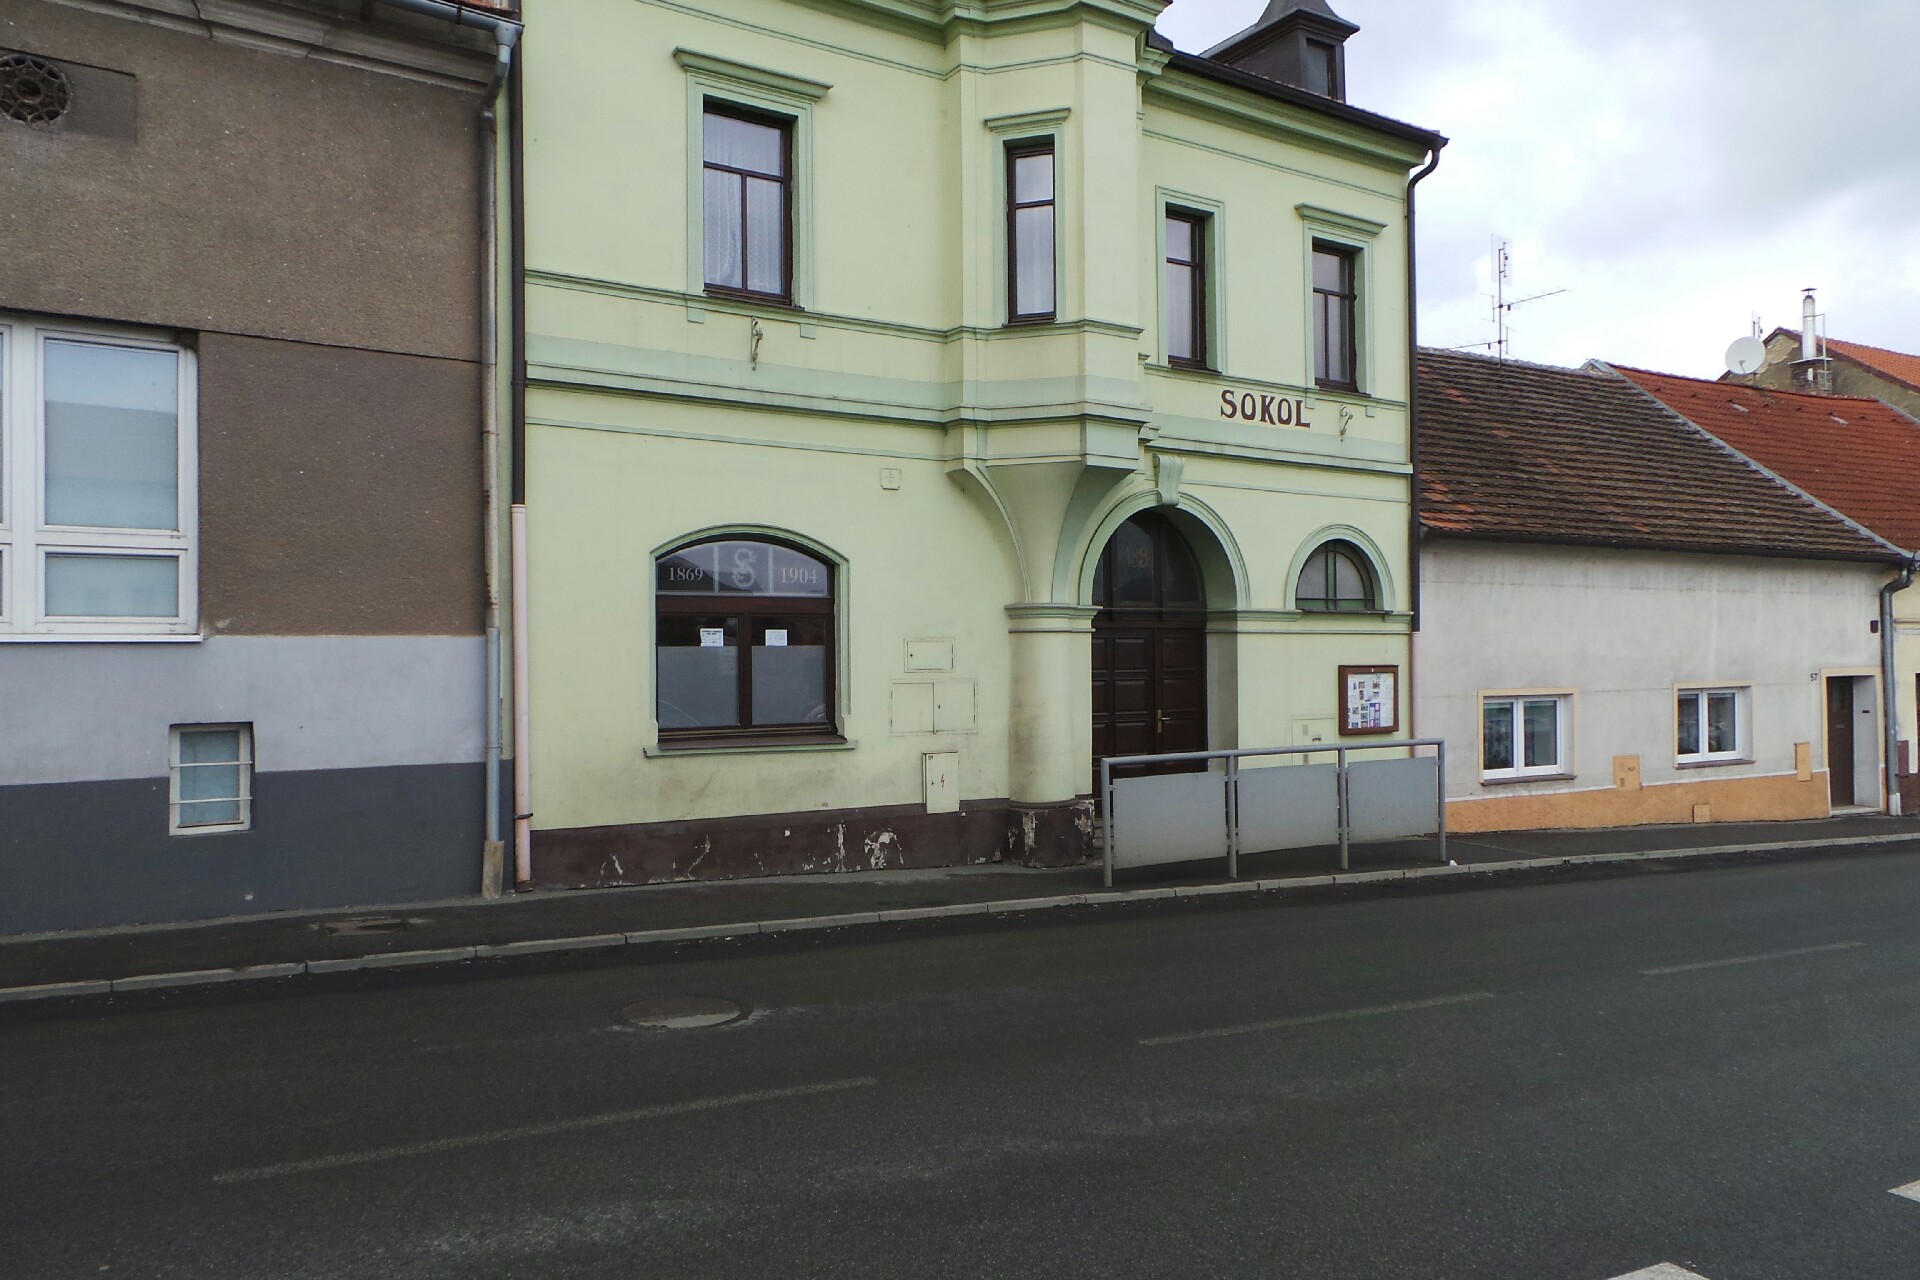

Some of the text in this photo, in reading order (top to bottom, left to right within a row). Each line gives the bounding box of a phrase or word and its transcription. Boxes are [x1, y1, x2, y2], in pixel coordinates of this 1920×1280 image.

[1220, 389, 1311, 429] SOKOL
[668, 566, 704, 582] 1869
[780, 566, 819, 584] 1904
[1810, 672, 1818, 682] 57
